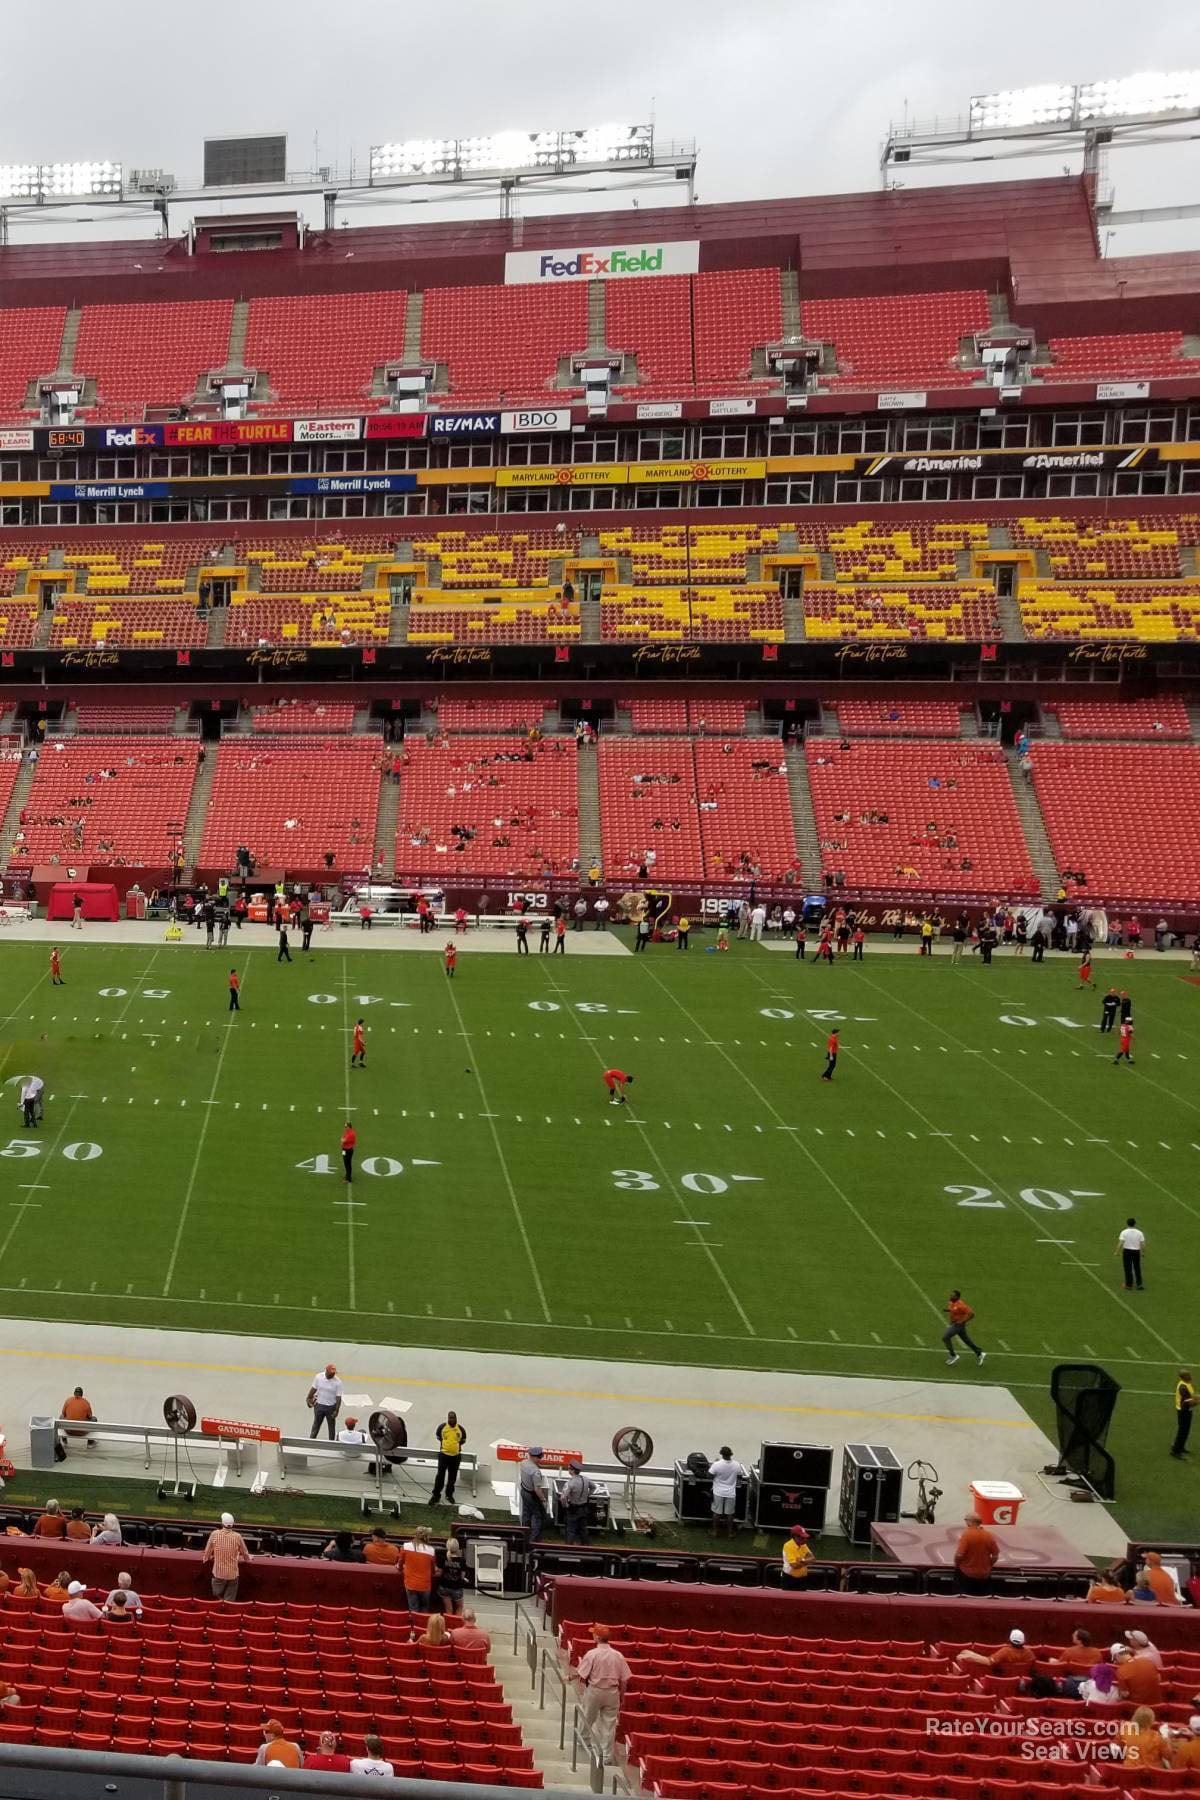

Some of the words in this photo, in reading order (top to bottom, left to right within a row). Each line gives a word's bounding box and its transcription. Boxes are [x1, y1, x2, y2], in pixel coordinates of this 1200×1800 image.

[540, 248, 663, 277] FedExField
[308, 419, 355, 431] Eastern
[434, 416, 496, 432] RE/MAX
[519, 411, 557, 427] BDO
[106, 429, 156, 447] FedEx
[512, 472, 555, 481] MARYLAND
[574, 471, 610, 480] LOTTERY
[645, 468, 691, 478] MARYLAND
[710, 467, 748, 476] LOTTERY
[331, 479, 361, 490] Merrill
[363, 478, 391, 490] Lynch
[87, 487, 117, 497] Merrill
[118, 486, 144, 497] Lynch
[700, 898, 733, 913] 198
[218, 1425, 261, 1437] GATORADE
[518, 1452, 564, 1463] GAADE
[993, 1506, 1013, 1524] G
